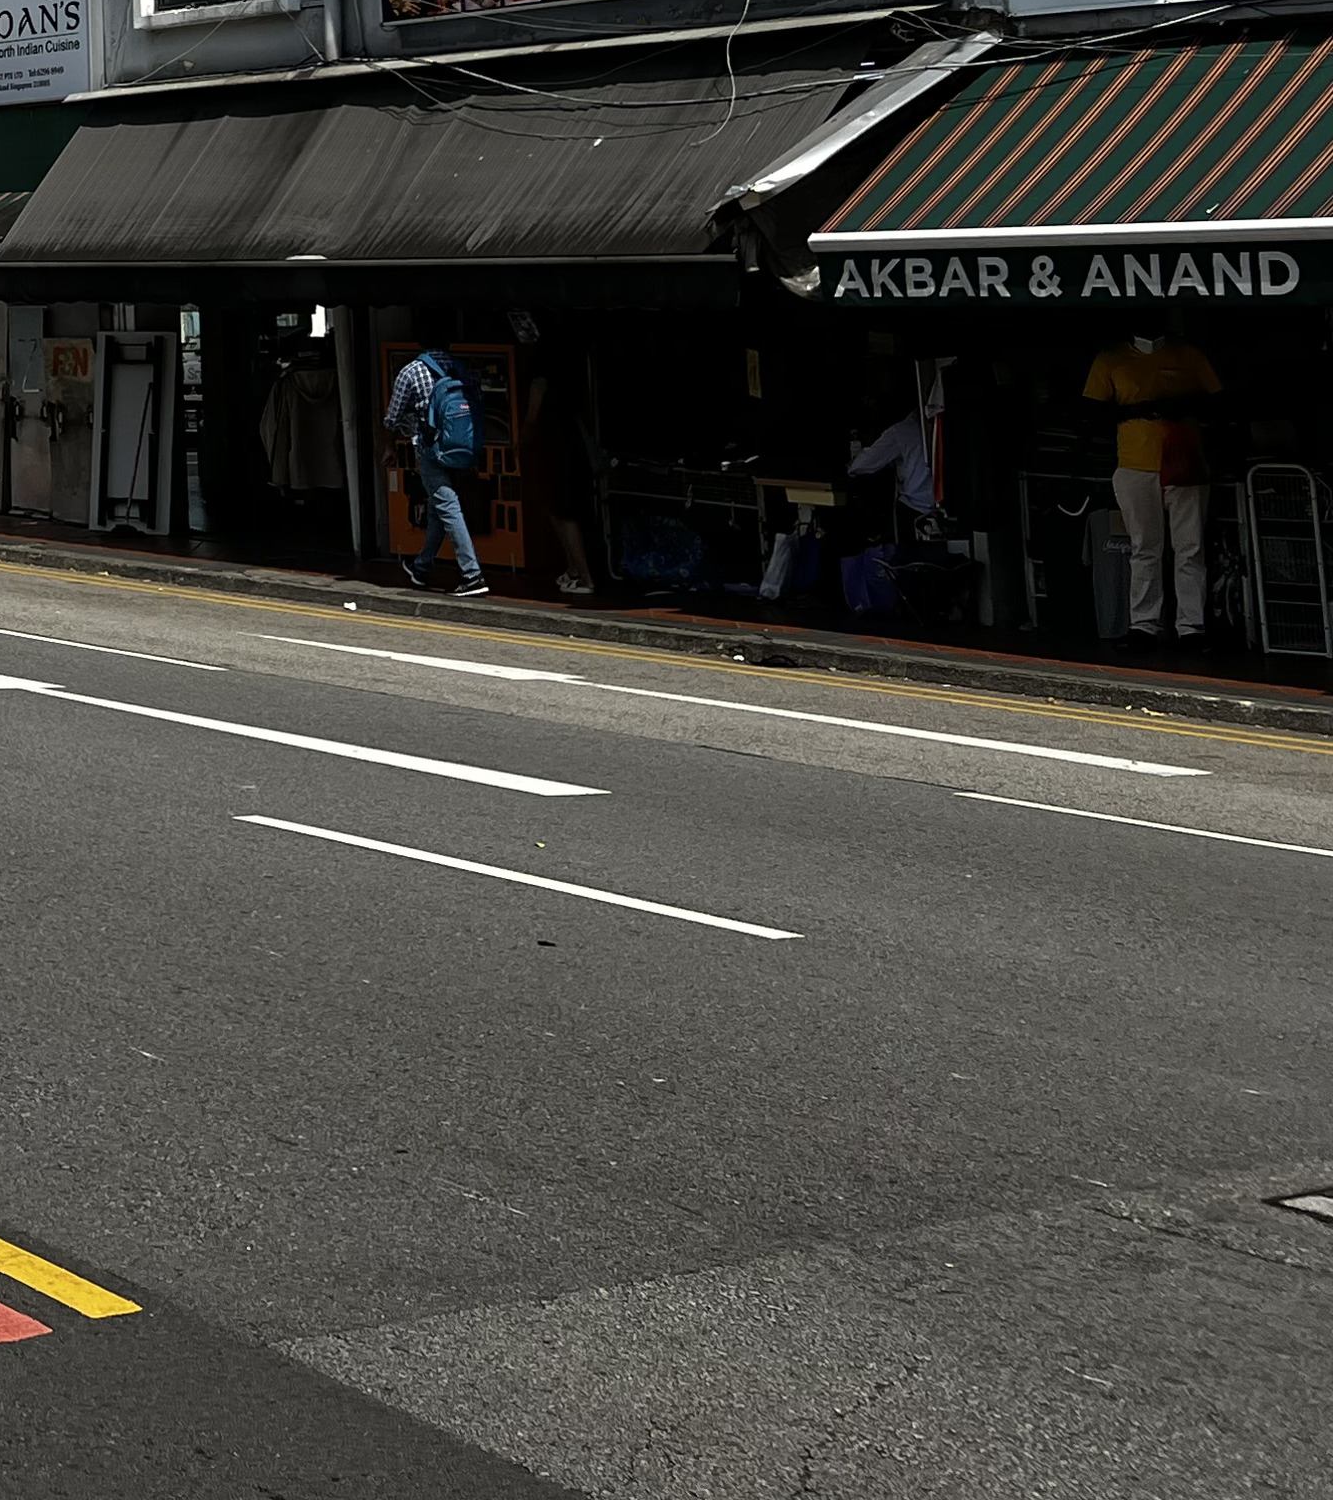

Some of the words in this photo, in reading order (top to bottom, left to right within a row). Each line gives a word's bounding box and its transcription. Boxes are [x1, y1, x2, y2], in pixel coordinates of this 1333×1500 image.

[16, 44, 43, 57] Indian
[45, 38, 80, 53] Cuisine
[833, 256, 1012, 299] AKBAR
[1028, 255, 1063, 298] &
[1080, 251, 1300, 298] ANAND
